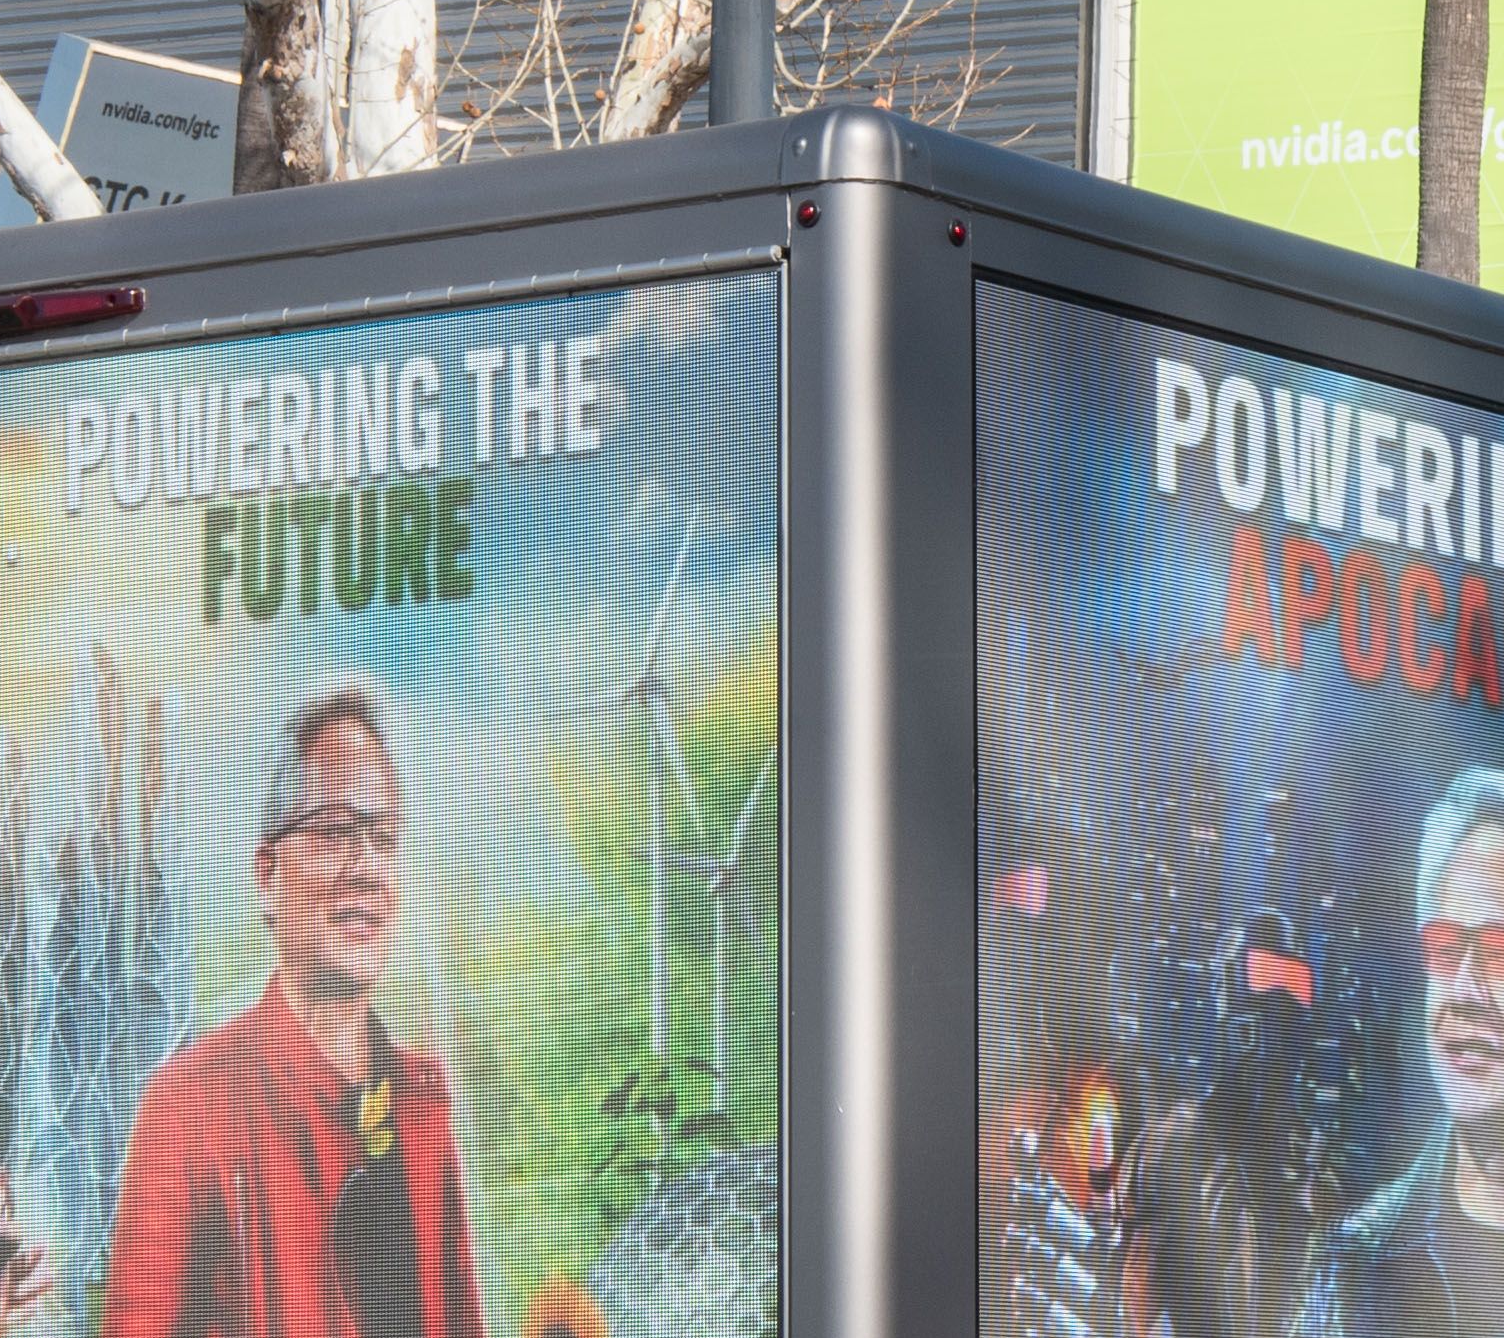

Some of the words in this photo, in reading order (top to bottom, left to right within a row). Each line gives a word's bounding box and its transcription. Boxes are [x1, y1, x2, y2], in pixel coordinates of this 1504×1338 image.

[102, 102, 222, 140] nvidia.com/gtc
[65, 355, 444, 517] POWERING
[465, 336, 601, 464] THE
[202, 475, 474, 625] FUTURE
